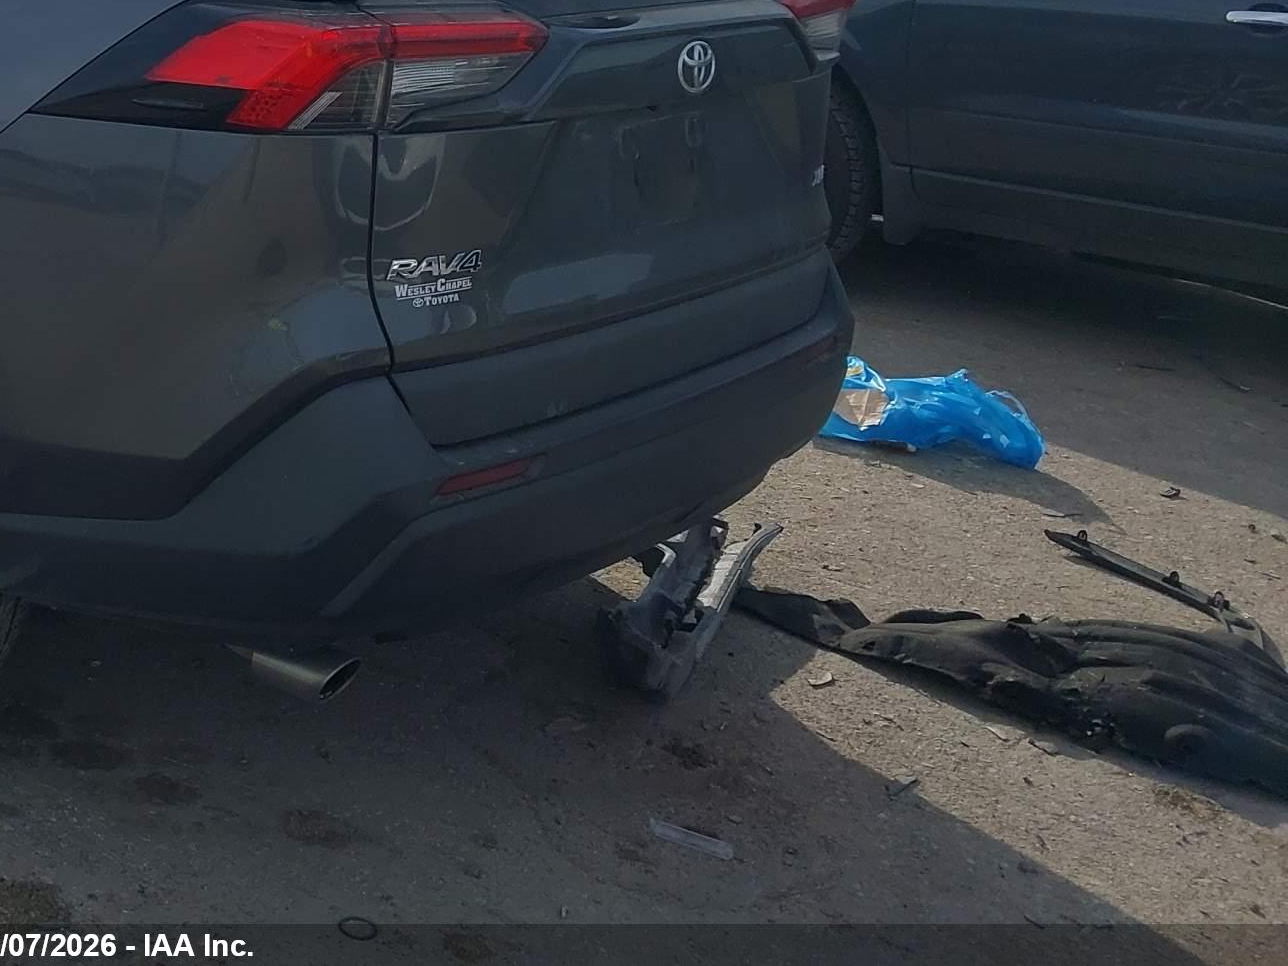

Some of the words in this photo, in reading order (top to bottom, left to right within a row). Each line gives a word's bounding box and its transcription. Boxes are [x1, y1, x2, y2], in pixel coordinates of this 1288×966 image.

[386, 249, 483, 280] RAV4
[394, 283, 436, 298] WESLEY
[436, 278, 473, 292] CHAPEL
[424, 293, 459, 306] TOYOTA
